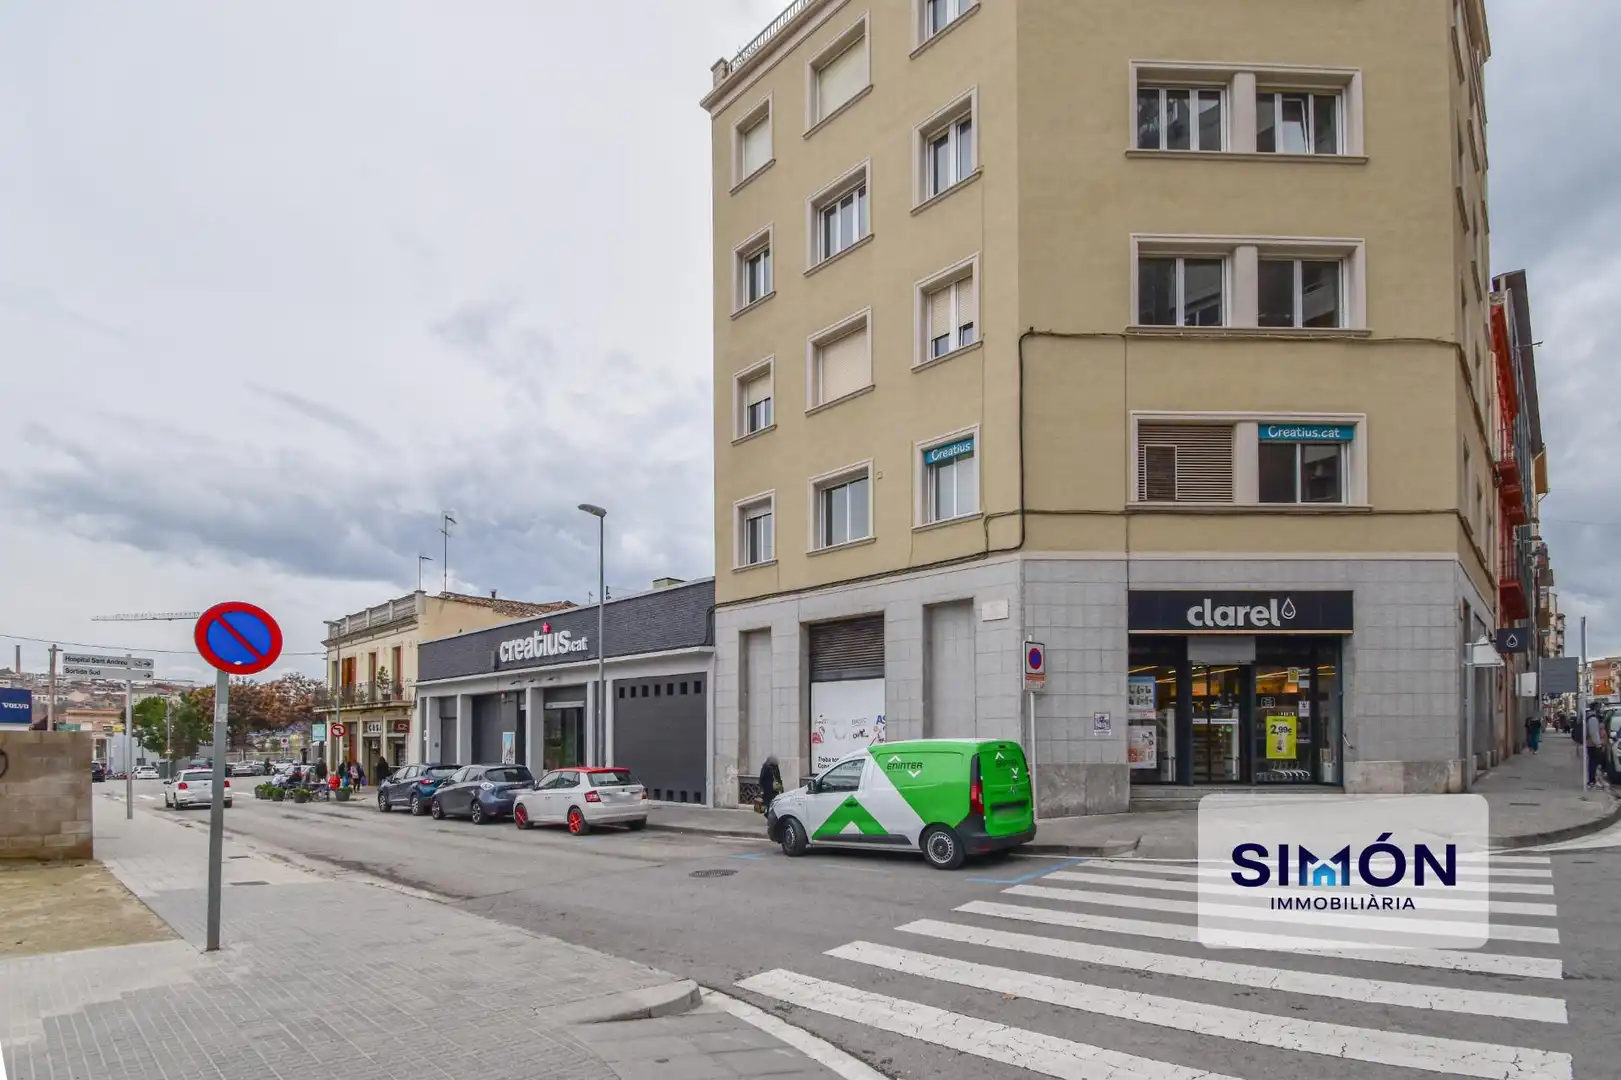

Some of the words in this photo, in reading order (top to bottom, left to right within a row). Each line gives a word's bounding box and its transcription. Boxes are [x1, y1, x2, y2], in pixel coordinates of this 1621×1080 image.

[1267, 425, 1341, 438] Creatius.cat
[931, 442, 971, 461] Creatius
[1186, 598, 1281, 627] clarel
[65, 655, 90, 664] Hospital
[89, 668, 100, 676] Sud
[1, 702, 30, 710] VOLVO
[886, 761, 924, 771] ENINTER
